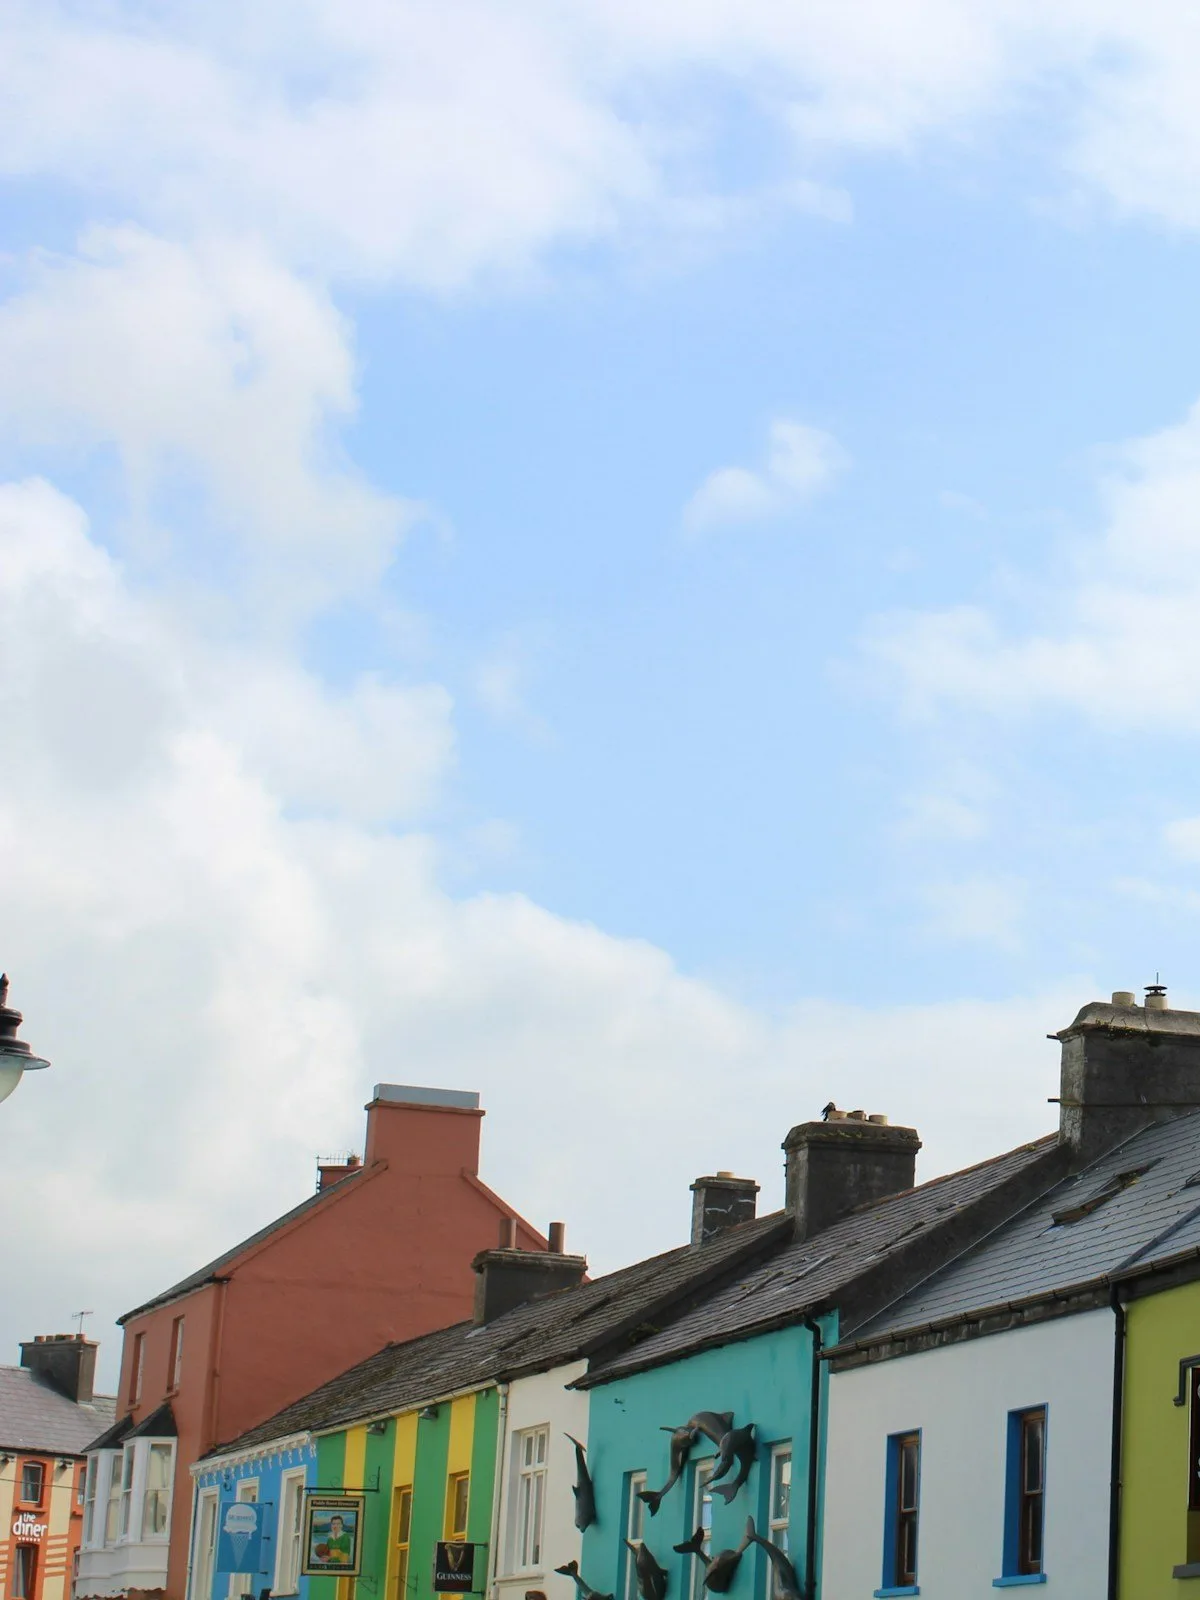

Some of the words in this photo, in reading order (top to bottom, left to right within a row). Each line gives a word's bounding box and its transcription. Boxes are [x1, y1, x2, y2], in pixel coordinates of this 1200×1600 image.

[23, 1512, 36, 1523] the
[12, 1514, 48, 1537] diner
[436, 1571, 472, 1581] GUINNESS
